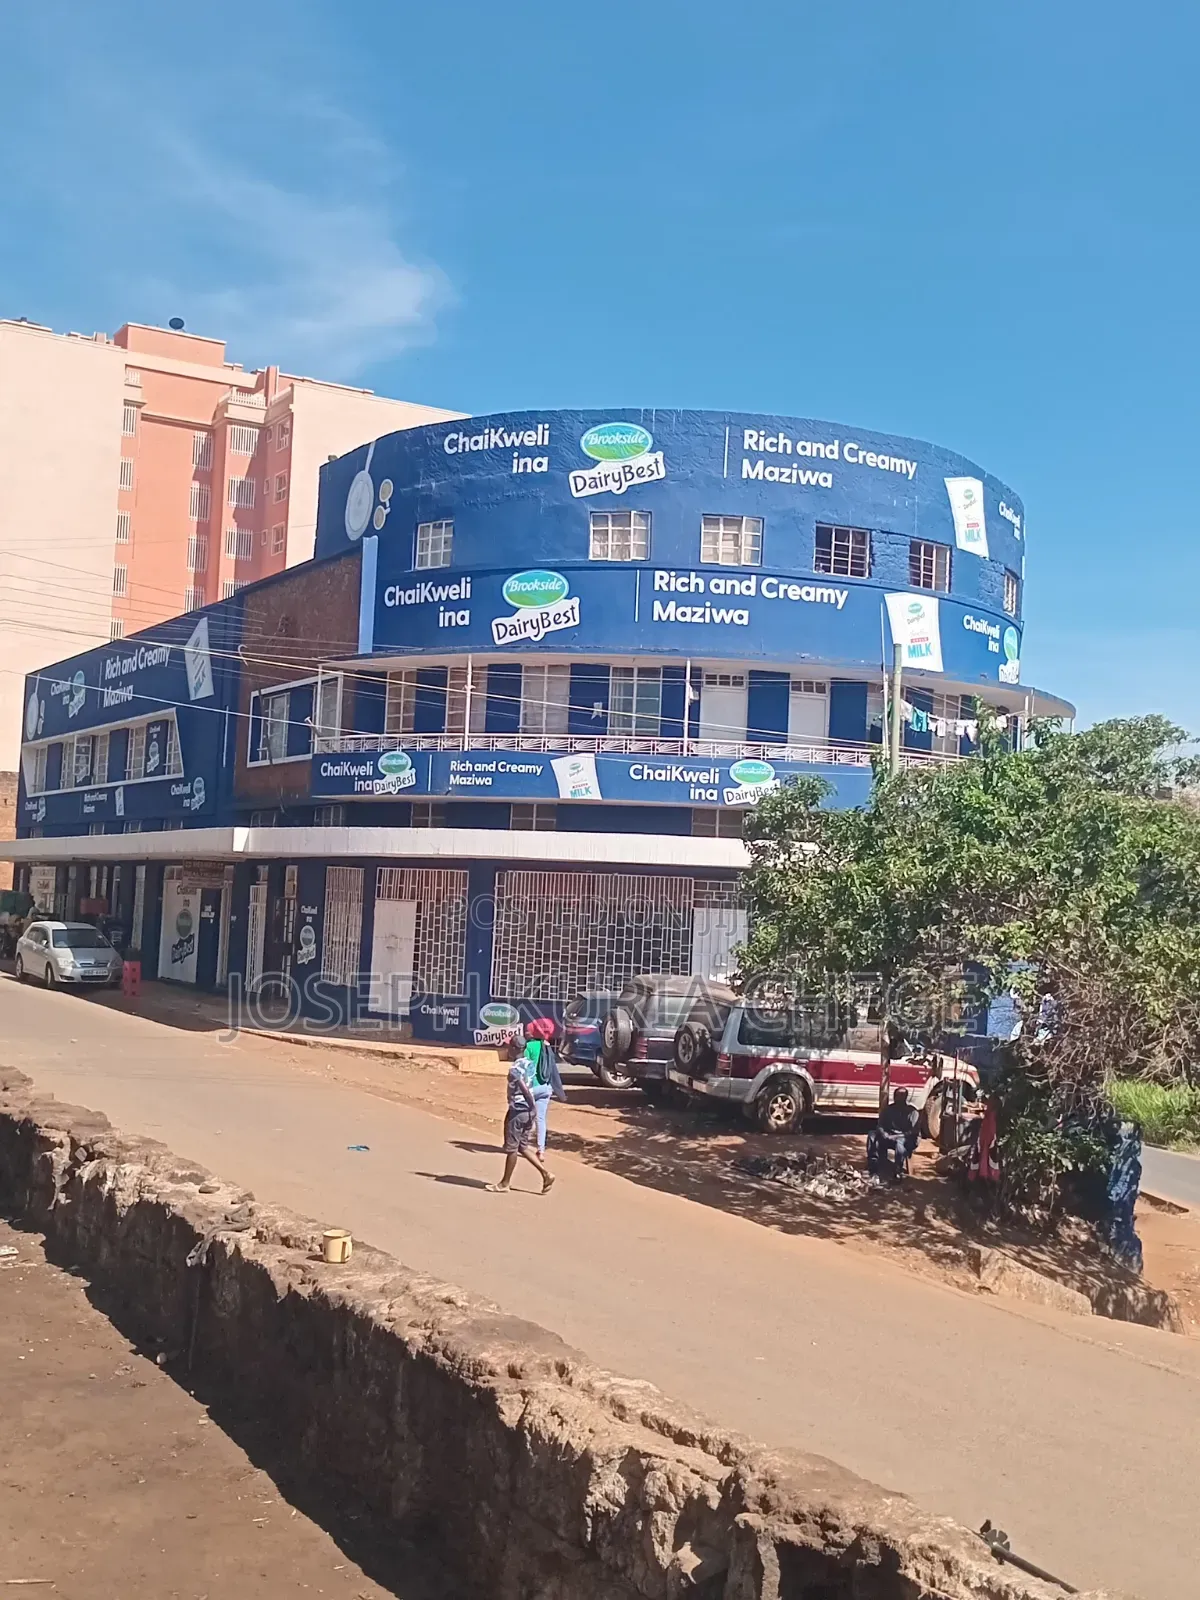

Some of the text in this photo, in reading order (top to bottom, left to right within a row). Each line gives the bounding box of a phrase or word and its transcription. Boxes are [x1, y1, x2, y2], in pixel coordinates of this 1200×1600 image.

[443, 423, 550, 455] ChaiKweli
[587, 431, 645, 446] Brookside
[512, 452, 549, 474] ina
[743, 429, 918, 480] Rich and Creamy
[572, 457, 661, 494] DairyBest
[741, 458, 833, 489] Maziwa
[384, 576, 471, 608] ChaiKweli
[508, 578, 563, 593] Brookside
[653, 570, 848, 610] Rich and Creamy
[439, 605, 470, 628] ina
[494, 604, 577, 641] DairyBest
[652, 600, 749, 627] Maziwa
[908, 642, 933, 659] MILK
[105, 656, 122, 681] Rich
[122, 648, 138, 674] and
[138, 644, 171, 672] Creamy
[103, 681, 134, 708] Maziwa
[320, 760, 374, 777] ChaiKweli
[449, 760, 544, 776] Rich and Creamy
[629, 764, 720, 784] ChaiKweli
[354, 777, 373, 792] ina
[373, 773, 415, 793] DairyBest
[449, 774, 493, 786] Maziwa
[570, 787, 592, 798] MILK
[689, 784, 718, 801] ina
